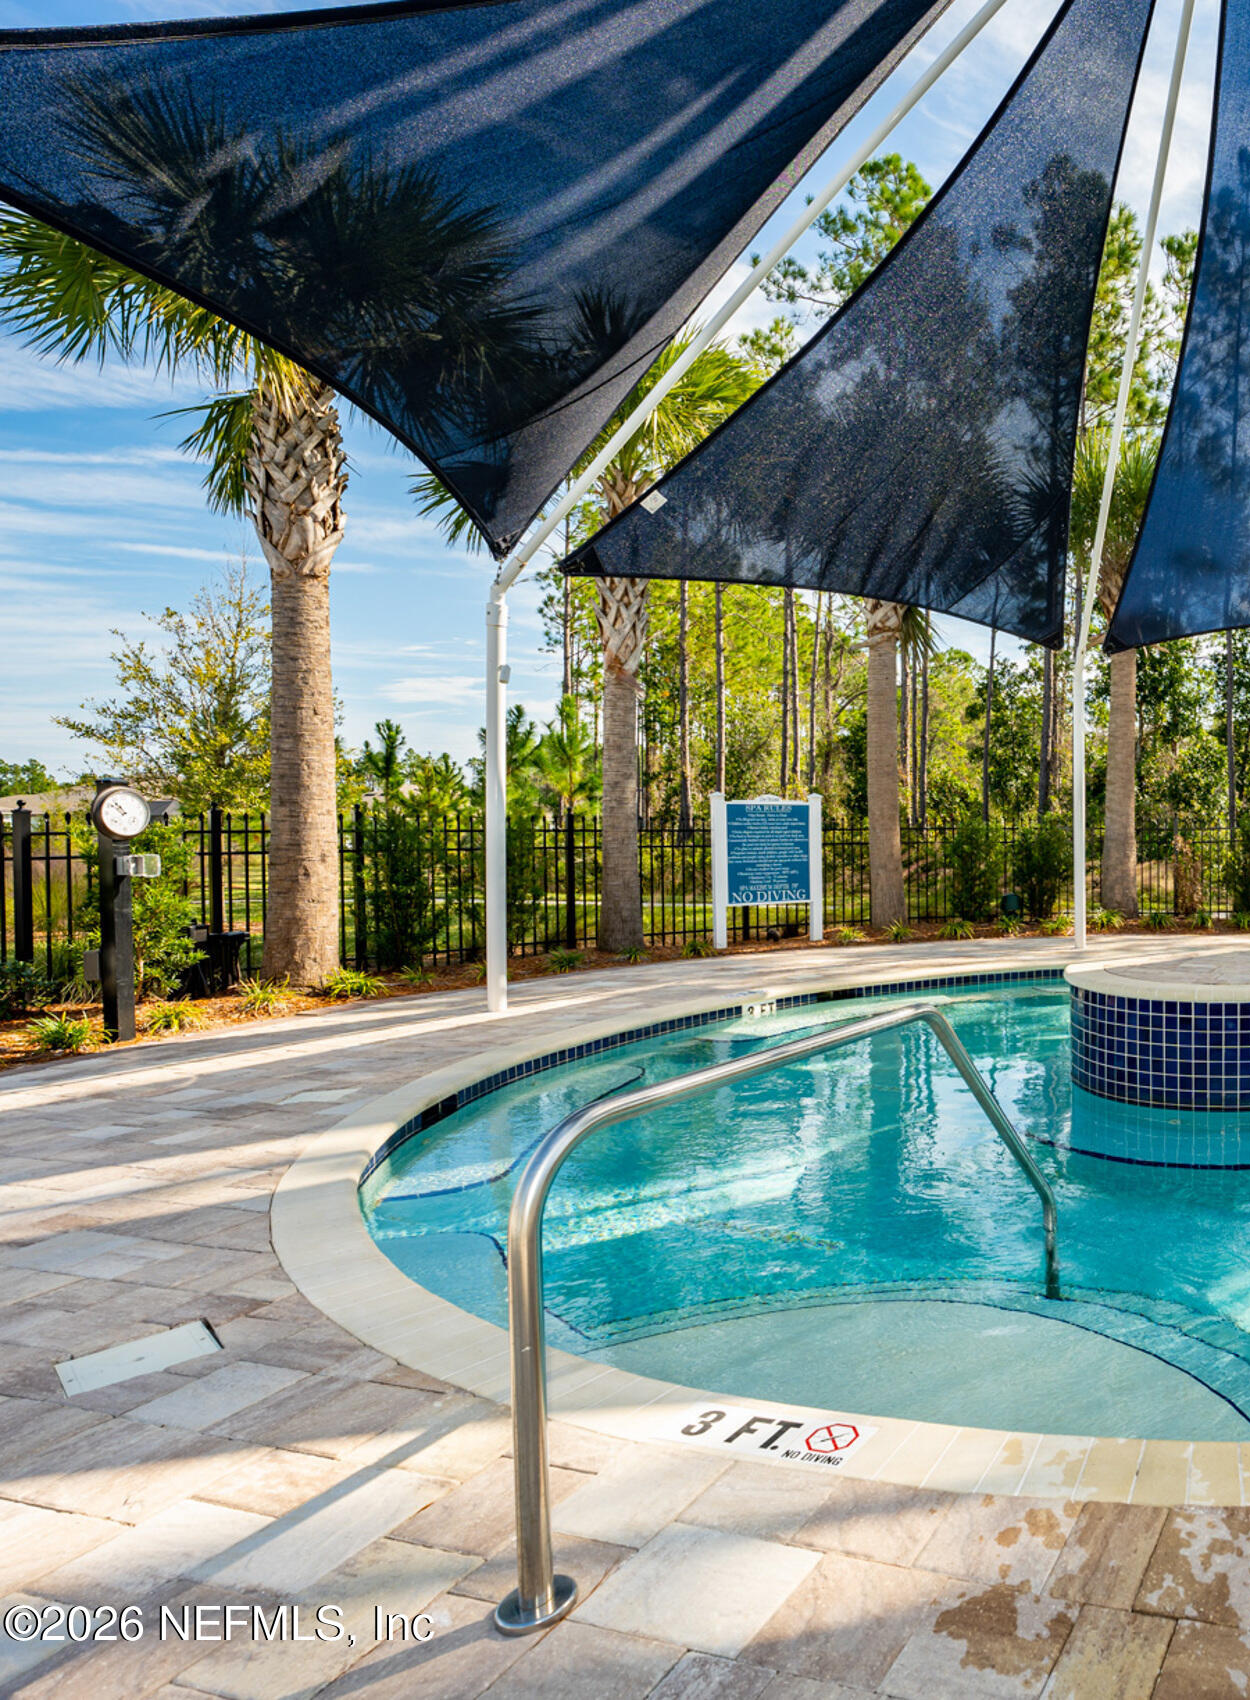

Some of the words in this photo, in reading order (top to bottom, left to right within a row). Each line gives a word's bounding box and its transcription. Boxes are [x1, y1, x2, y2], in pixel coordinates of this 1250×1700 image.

[745, 804, 761, 812] SPA
[763, 804, 792, 812] RULES
[732, 891, 753, 904] NO
[756, 889, 806, 903] DIVING
[760, 1002, 774, 1013] FT
[680, 1410, 727, 1437] 3
[723, 1415, 804, 1451] FT.
[780, 1449, 801, 1459] NO
[800, 1451, 844, 1466] DIVING
